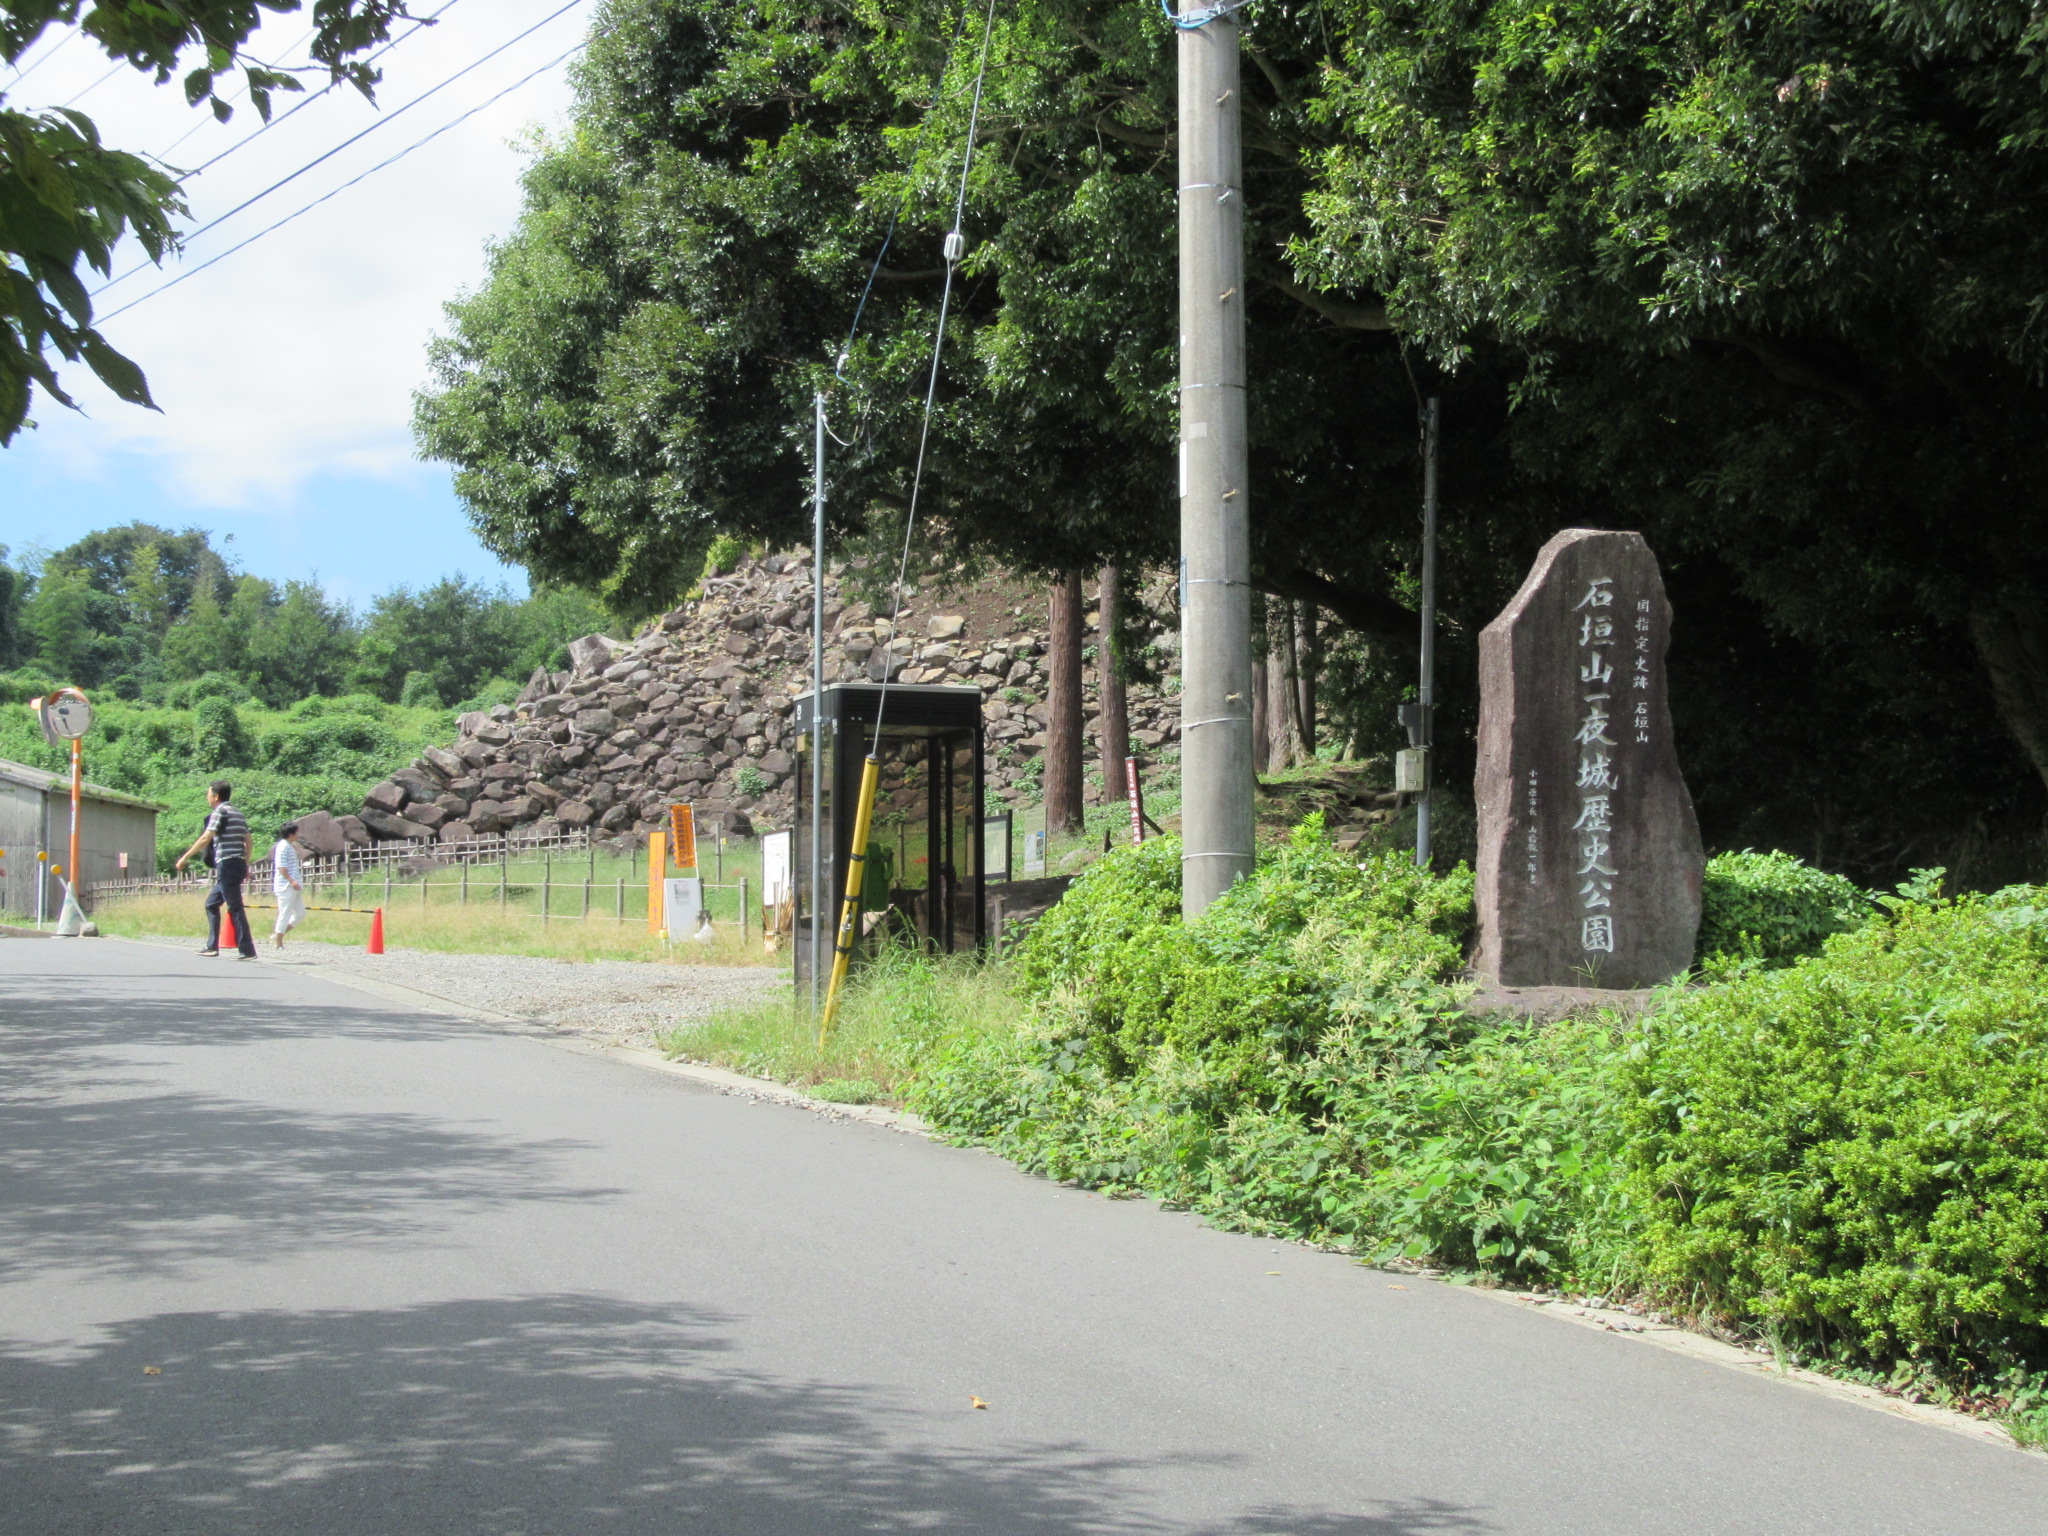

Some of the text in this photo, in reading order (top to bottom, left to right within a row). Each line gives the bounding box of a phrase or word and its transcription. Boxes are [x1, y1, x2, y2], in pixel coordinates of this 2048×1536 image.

[1572, 576, 1618, 953] 石垣山一夜城歴史公園
[1632, 599, 1650, 743] 国指定史跡 石垣山
